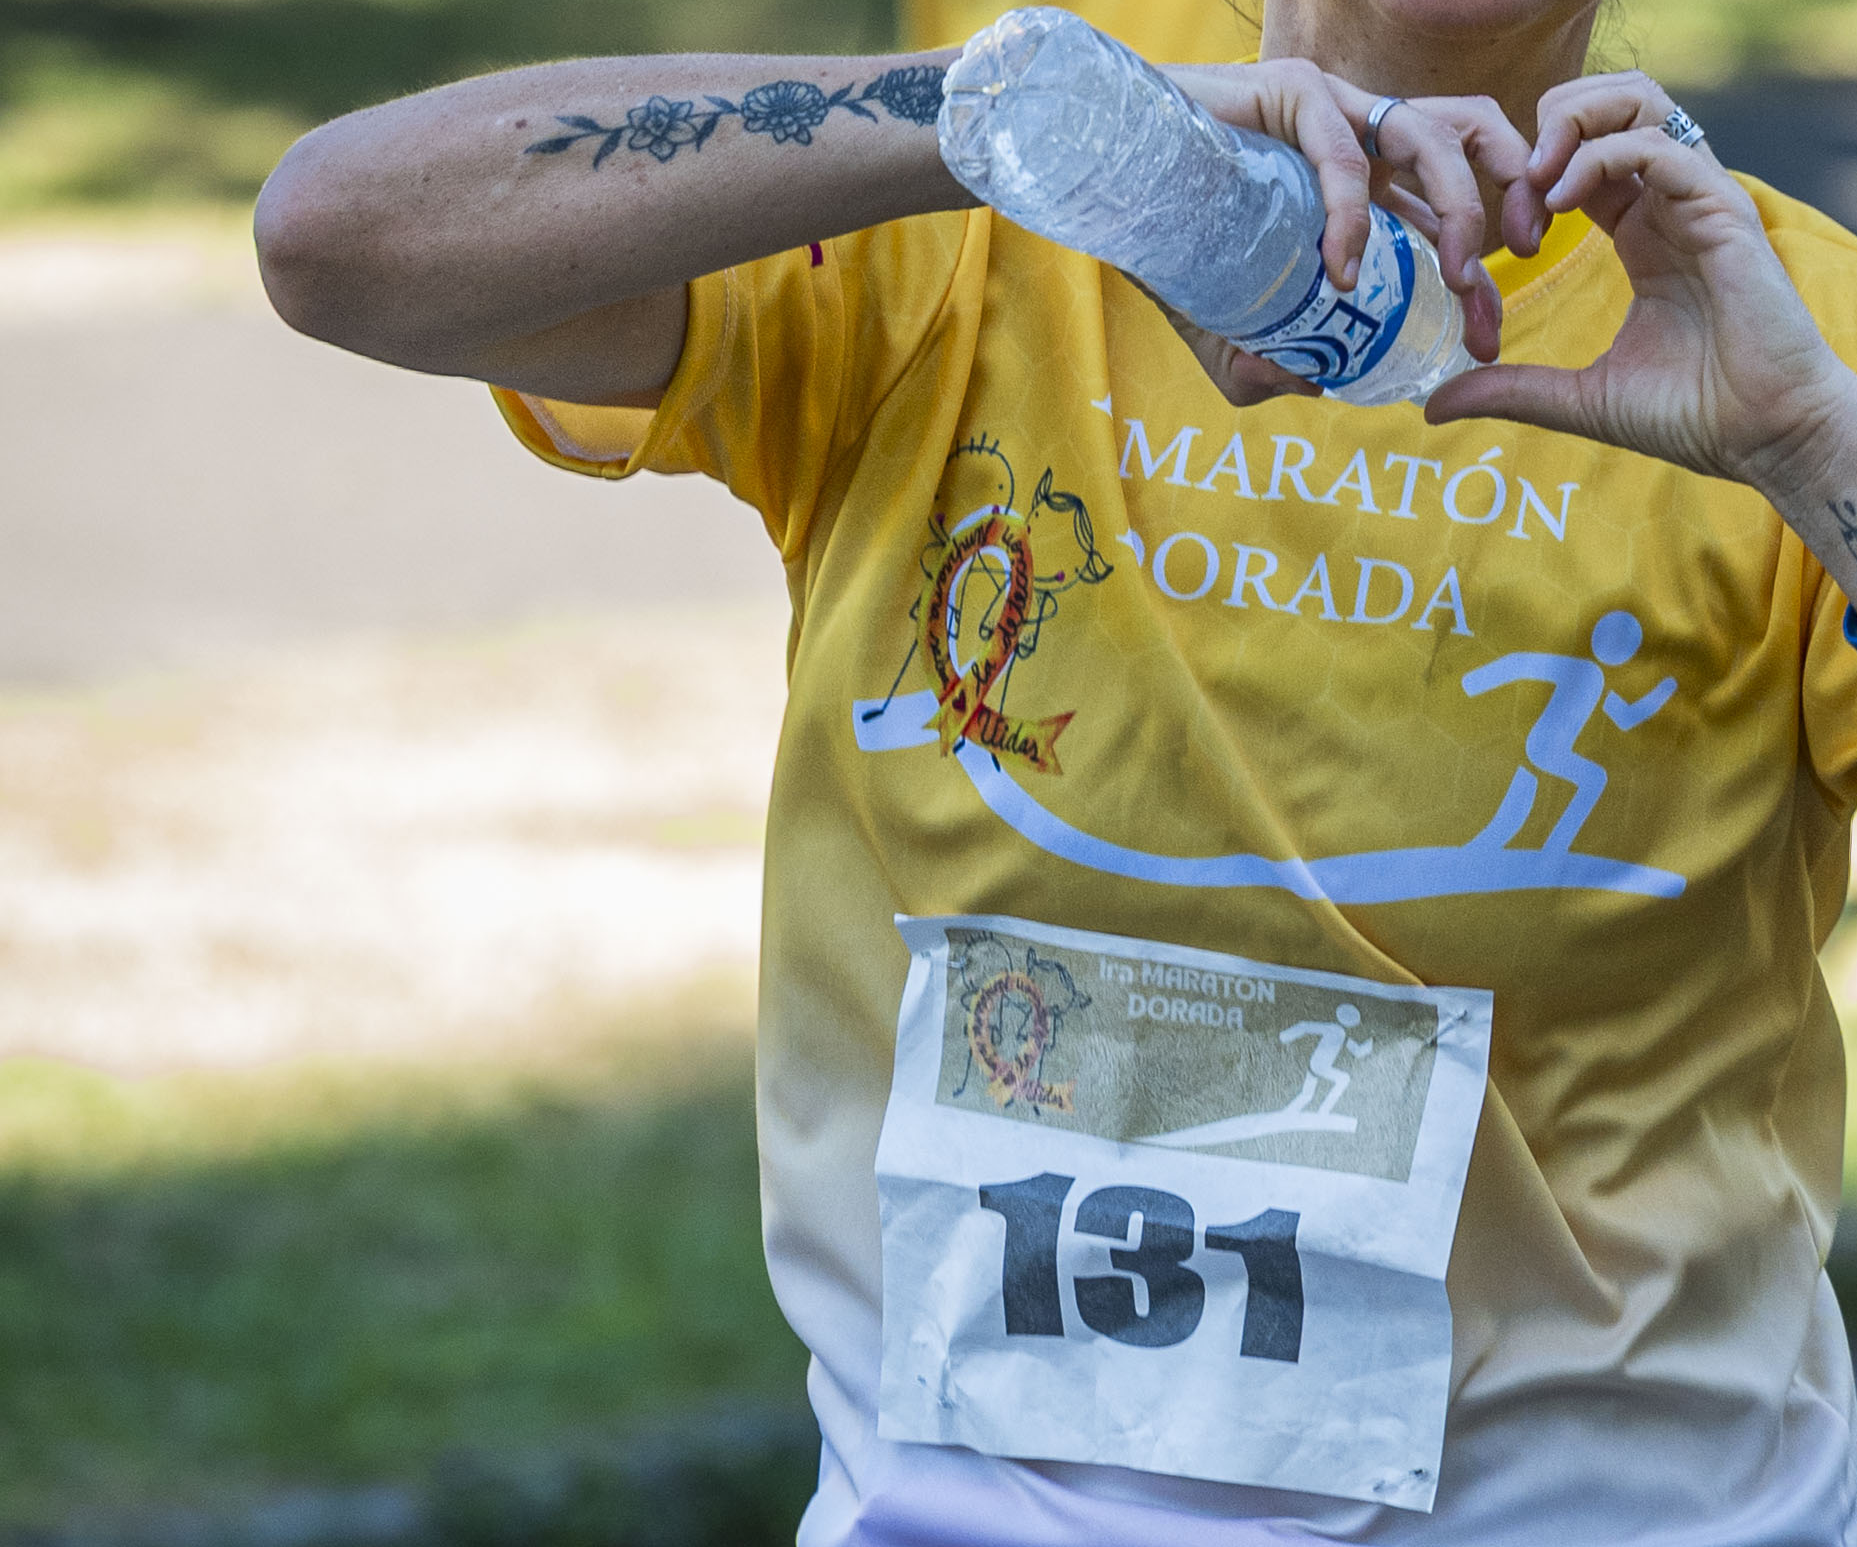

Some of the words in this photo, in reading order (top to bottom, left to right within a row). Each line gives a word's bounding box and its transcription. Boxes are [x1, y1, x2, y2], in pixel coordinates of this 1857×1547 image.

[1118, 418, 1581, 542] MARATÓN
[1114, 528, 1475, 638] ORADA
[1127, 991, 1245, 1030] DORADA
[979, 1172, 1304, 1364] 131
